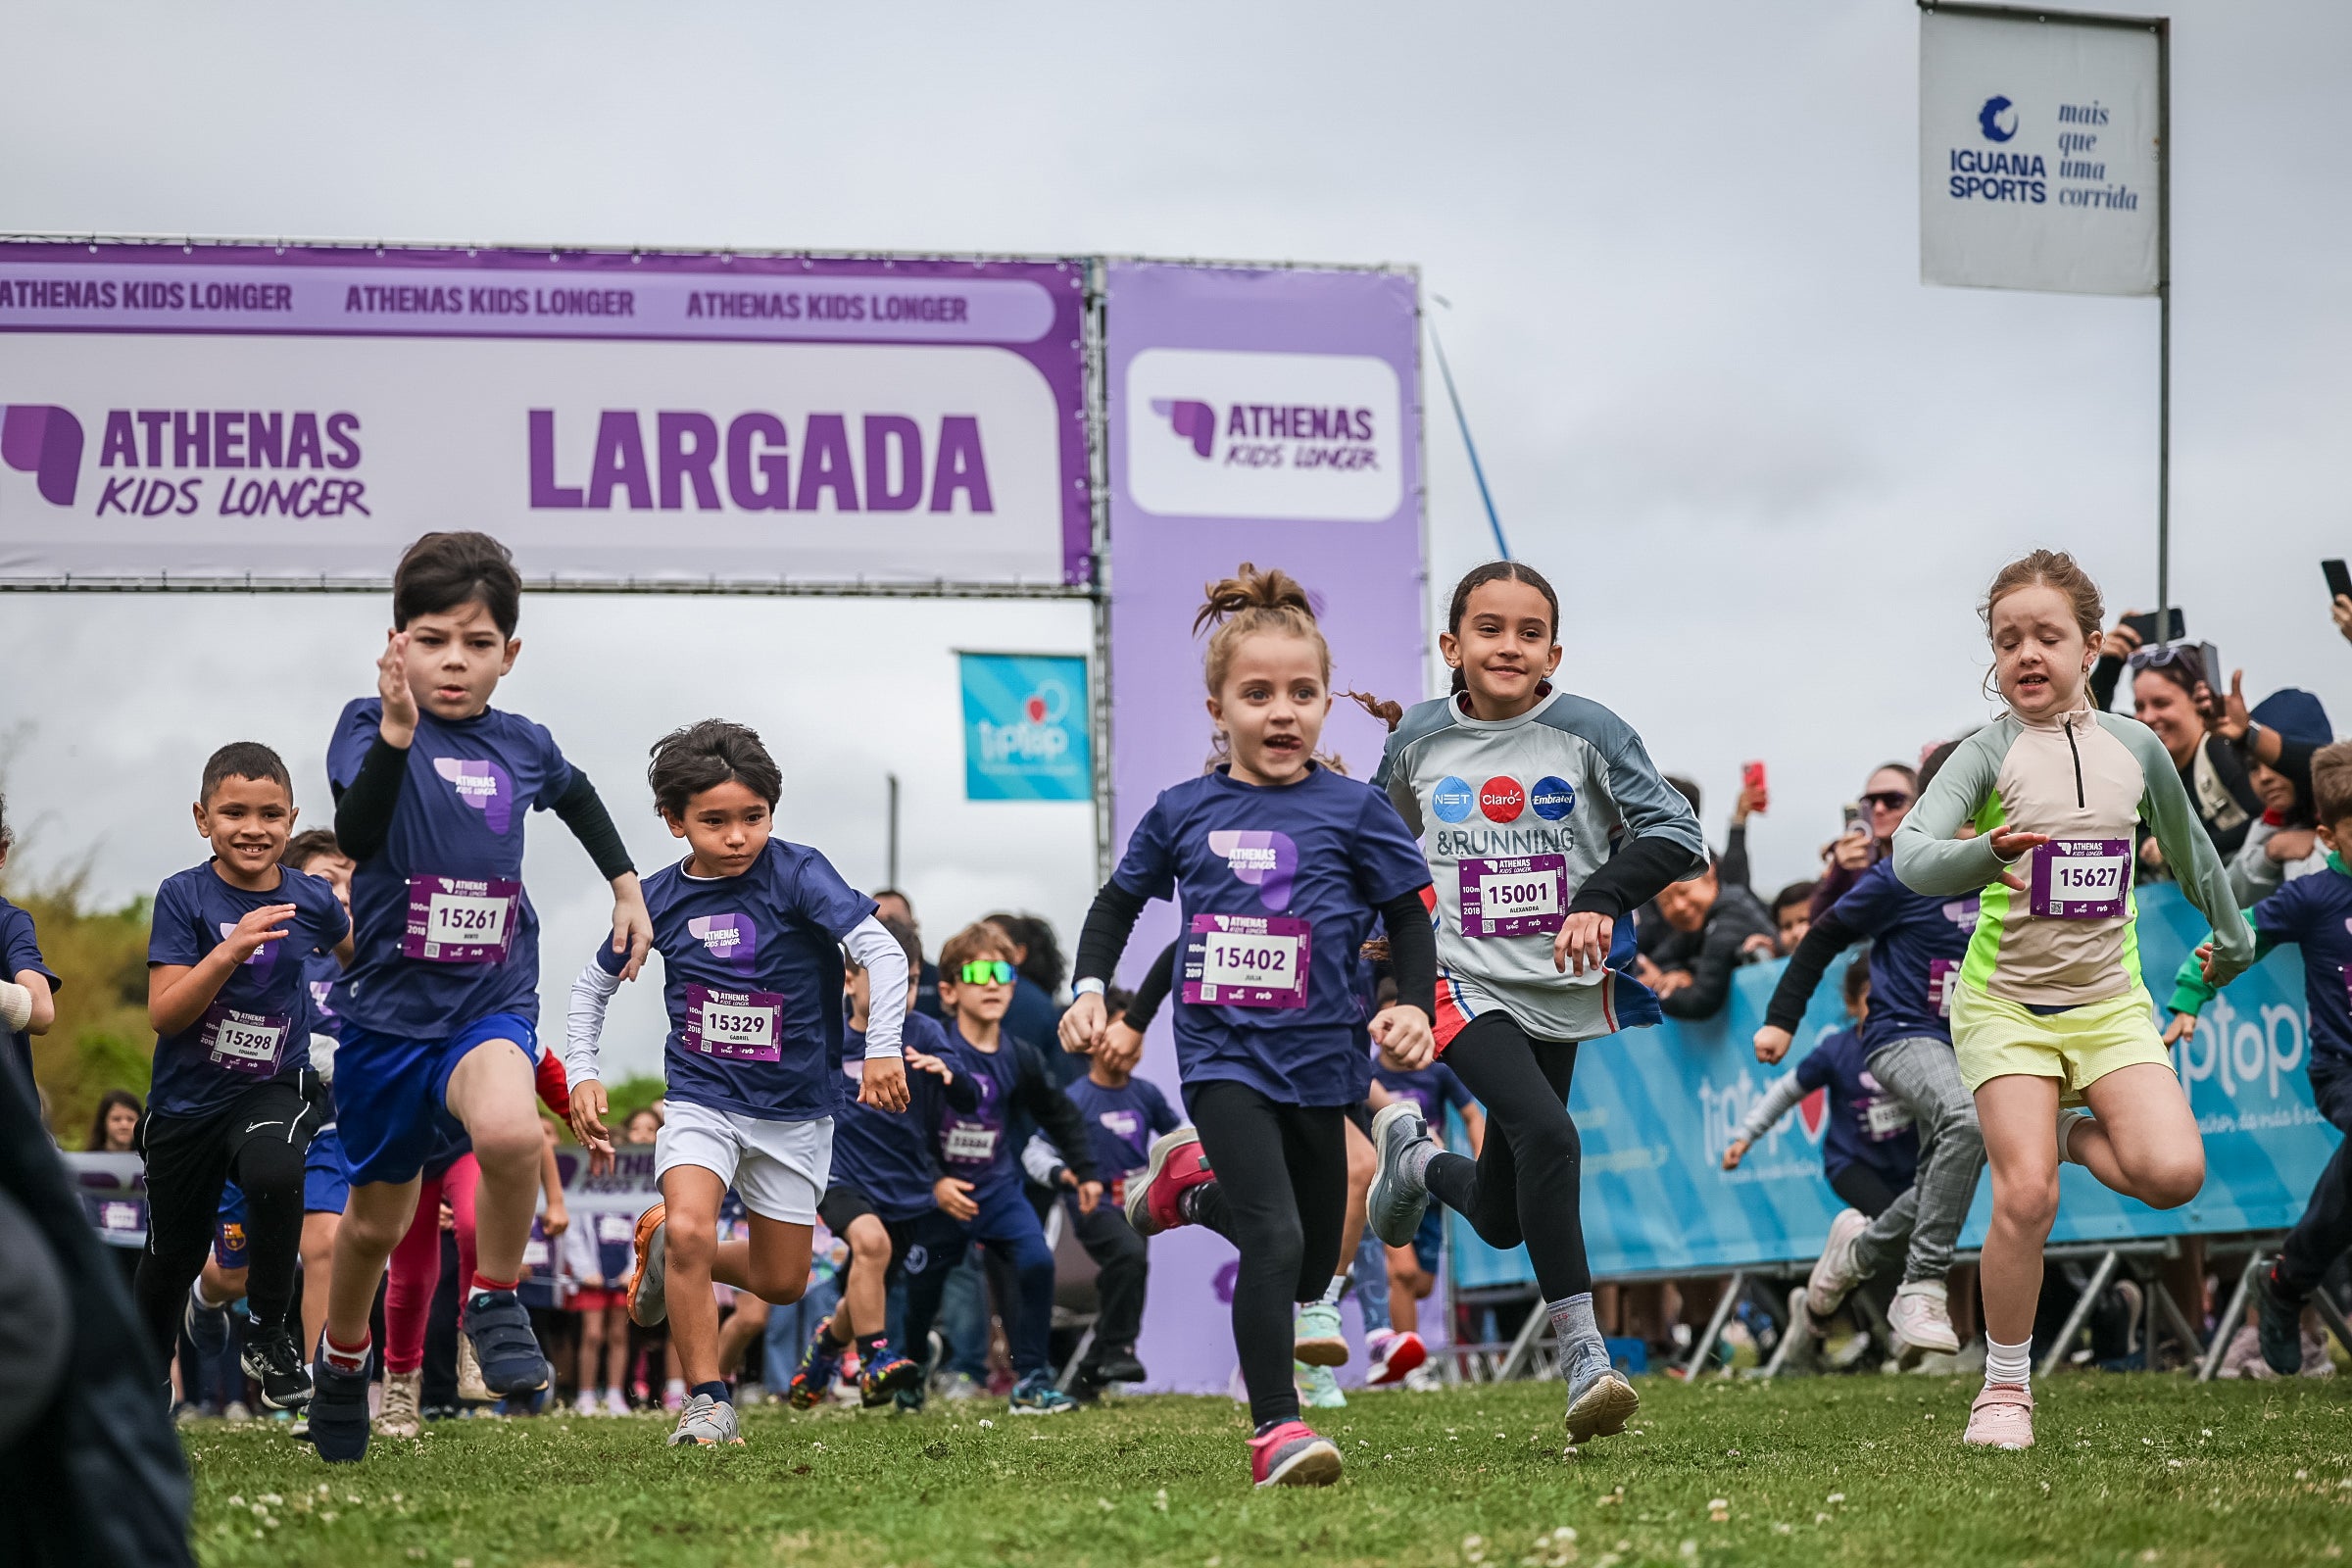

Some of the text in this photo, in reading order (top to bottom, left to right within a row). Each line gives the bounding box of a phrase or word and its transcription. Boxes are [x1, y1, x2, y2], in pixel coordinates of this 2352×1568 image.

[2058, 100, 2109, 125] mais
[2058, 131, 2097, 157] que
[1949, 149, 2047, 177] IGUANA
[2059, 159, 2105, 180] uma
[1949, 175, 2047, 205] SPORTS
[2059, 183, 2138, 211] corrida
[0, 280, 293, 312] ATHENAS KIDS LONGER
[345, 285, 635, 317] ATHENAS KIDS LONGER
[687, 291, 969, 324] ATHENAS KIDS LONGER
[1227, 405, 1373, 441] ATHENAS
[100, 410, 362, 469] ATHENAS
[528, 409, 996, 514] LARGADA
[1225, 444, 1381, 472] KIDS LONGER
[96, 475, 371, 518] KIDS LONGER
[456, 775, 496, 788] ATHENAS
[1435, 794, 1470, 805] NET
[1483, 793, 1517, 806] Claro
[1533, 794, 1573, 805] Embratel
[1437, 827, 1575, 857] &RUNNING
[2073, 842, 2103, 851] ATHENAS
[1228, 848, 1277, 861] ATHENAS
[1499, 858, 1531, 868] ATHENAS
[455, 880, 488, 891] ATHENAS
[2060, 868, 2117, 887] 15627
[1489, 882, 1546, 904] 15001
[410, 902, 430, 912] 100m
[439, 907, 497, 930] 15261
[408, 924, 426, 937] 2018
[704, 928, 740, 942] ATHENAS
[1215, 947, 1286, 971] 15402
[719, 992, 750, 1002] ATHENAS
[240, 1012, 266, 1023] ATHENAS
[689, 1006, 703, 1015] 100m
[687, 1025, 702, 1034] 2018
[710, 1013, 765, 1033] 15329
[200, 1037, 215, 1047] 2018
[225, 1029, 272, 1050] 15298
